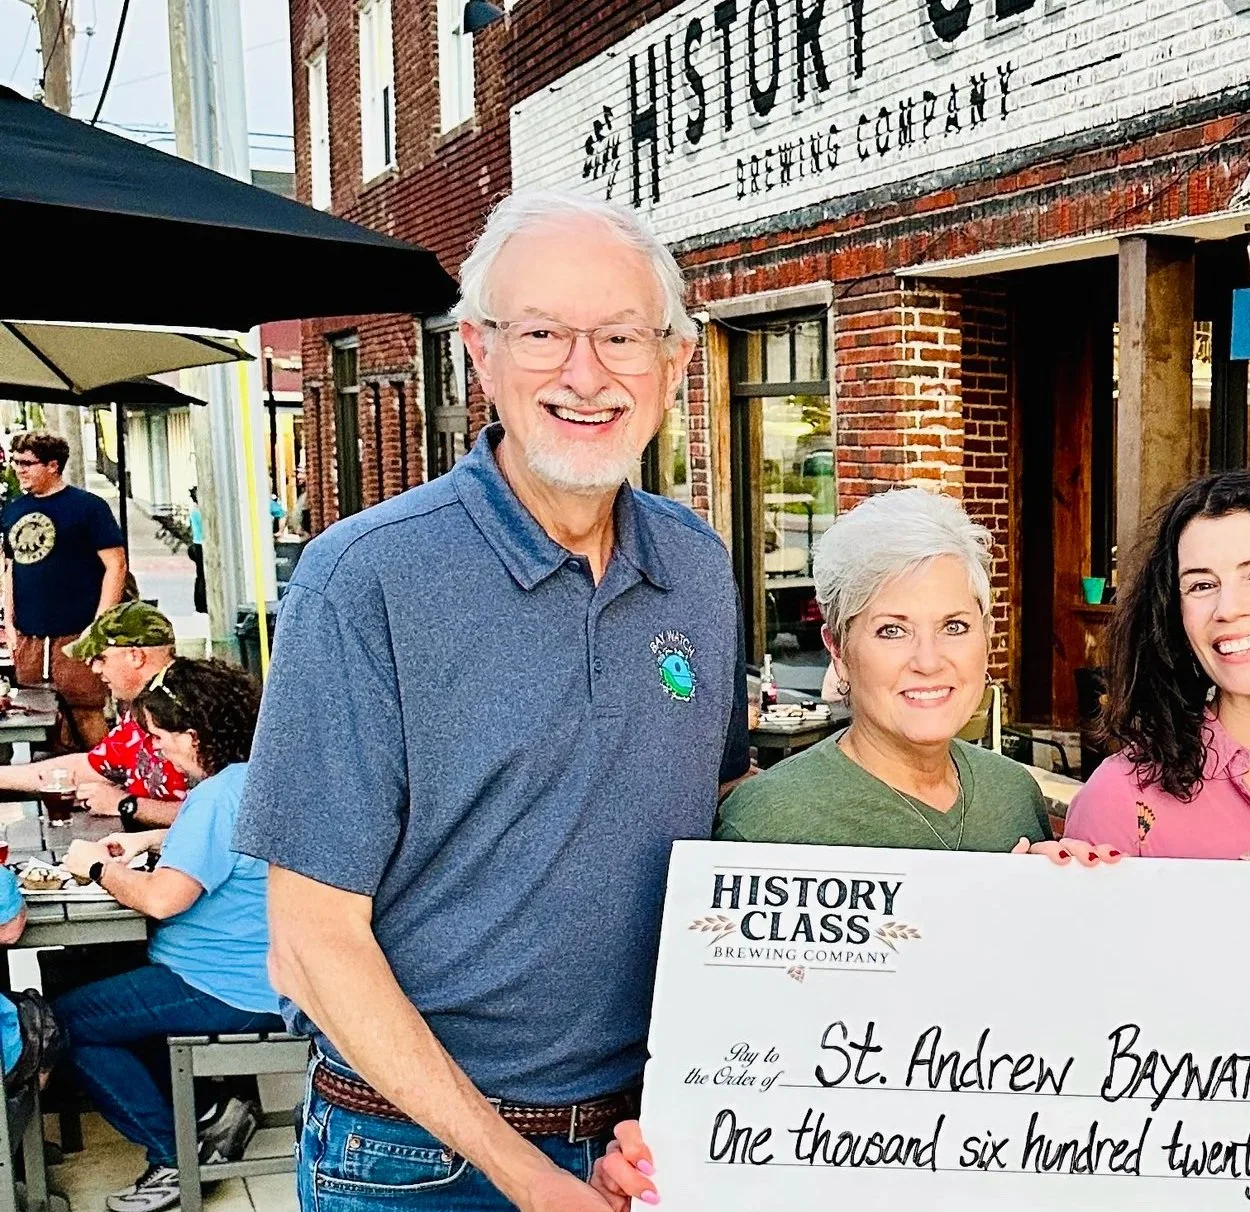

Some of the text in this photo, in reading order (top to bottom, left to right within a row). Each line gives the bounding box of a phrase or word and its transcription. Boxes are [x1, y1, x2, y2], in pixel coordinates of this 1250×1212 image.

[736, 60, 1016, 200] BREWING COMPANY
[649, 629, 696, 659] BAY WATCH
[710, 873, 903, 916] HISTORY
[740, 910, 870, 945] CLASS
[713, 946, 890, 965] BREWING COMPANY
[724, 1042, 780, 1064] Pay to
[814, 1020, 888, 1088] St.
[905, 1025, 1075, 1096] Andrew
[683, 1066, 784, 1092] the Order of
[709, 1108, 775, 1165] One
[788, 1107, 946, 1173] thousand
[959, 1130, 1009, 1172] six
[1021, 1111, 1152, 1177] hundred
